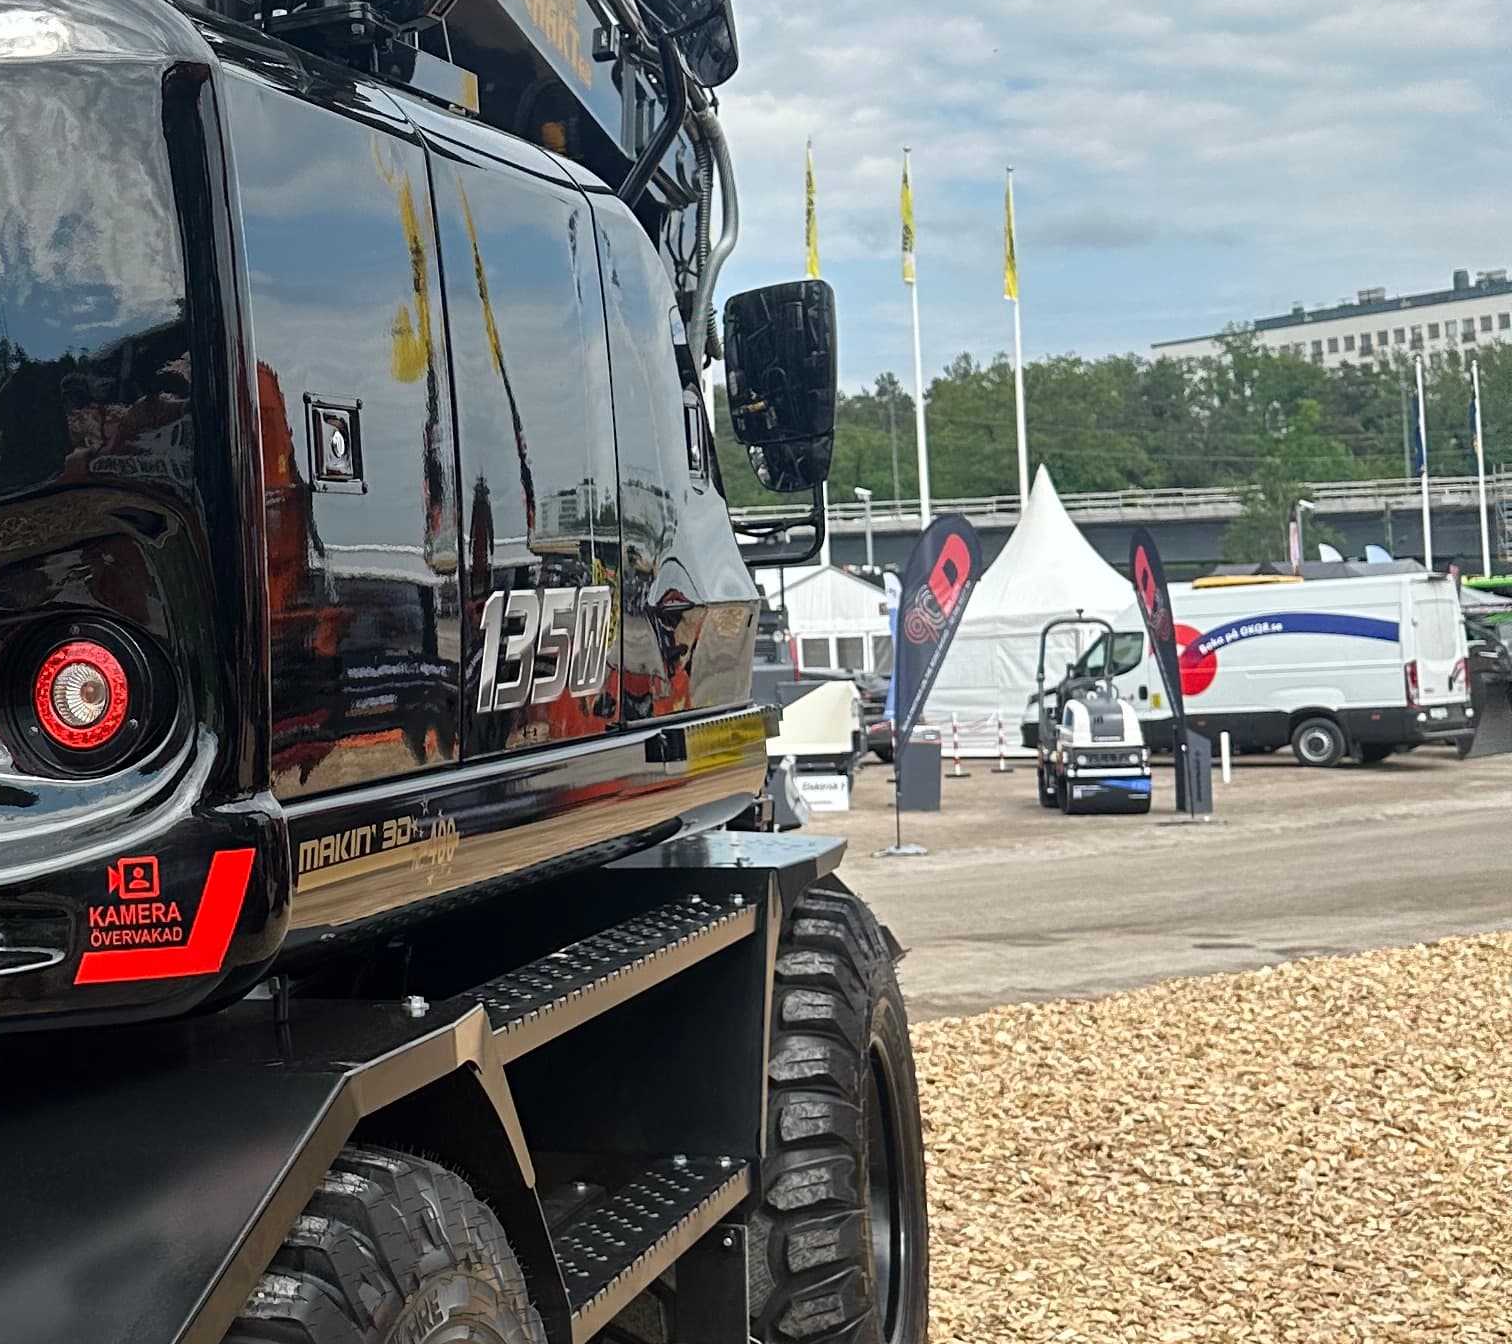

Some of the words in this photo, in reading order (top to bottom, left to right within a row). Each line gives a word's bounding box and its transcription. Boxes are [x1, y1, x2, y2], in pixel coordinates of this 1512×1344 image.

[382, 816, 412, 849] 3D
[89, 902, 182, 928] KAMERA
[90, 926, 183, 948] ÖVERVAKAD
